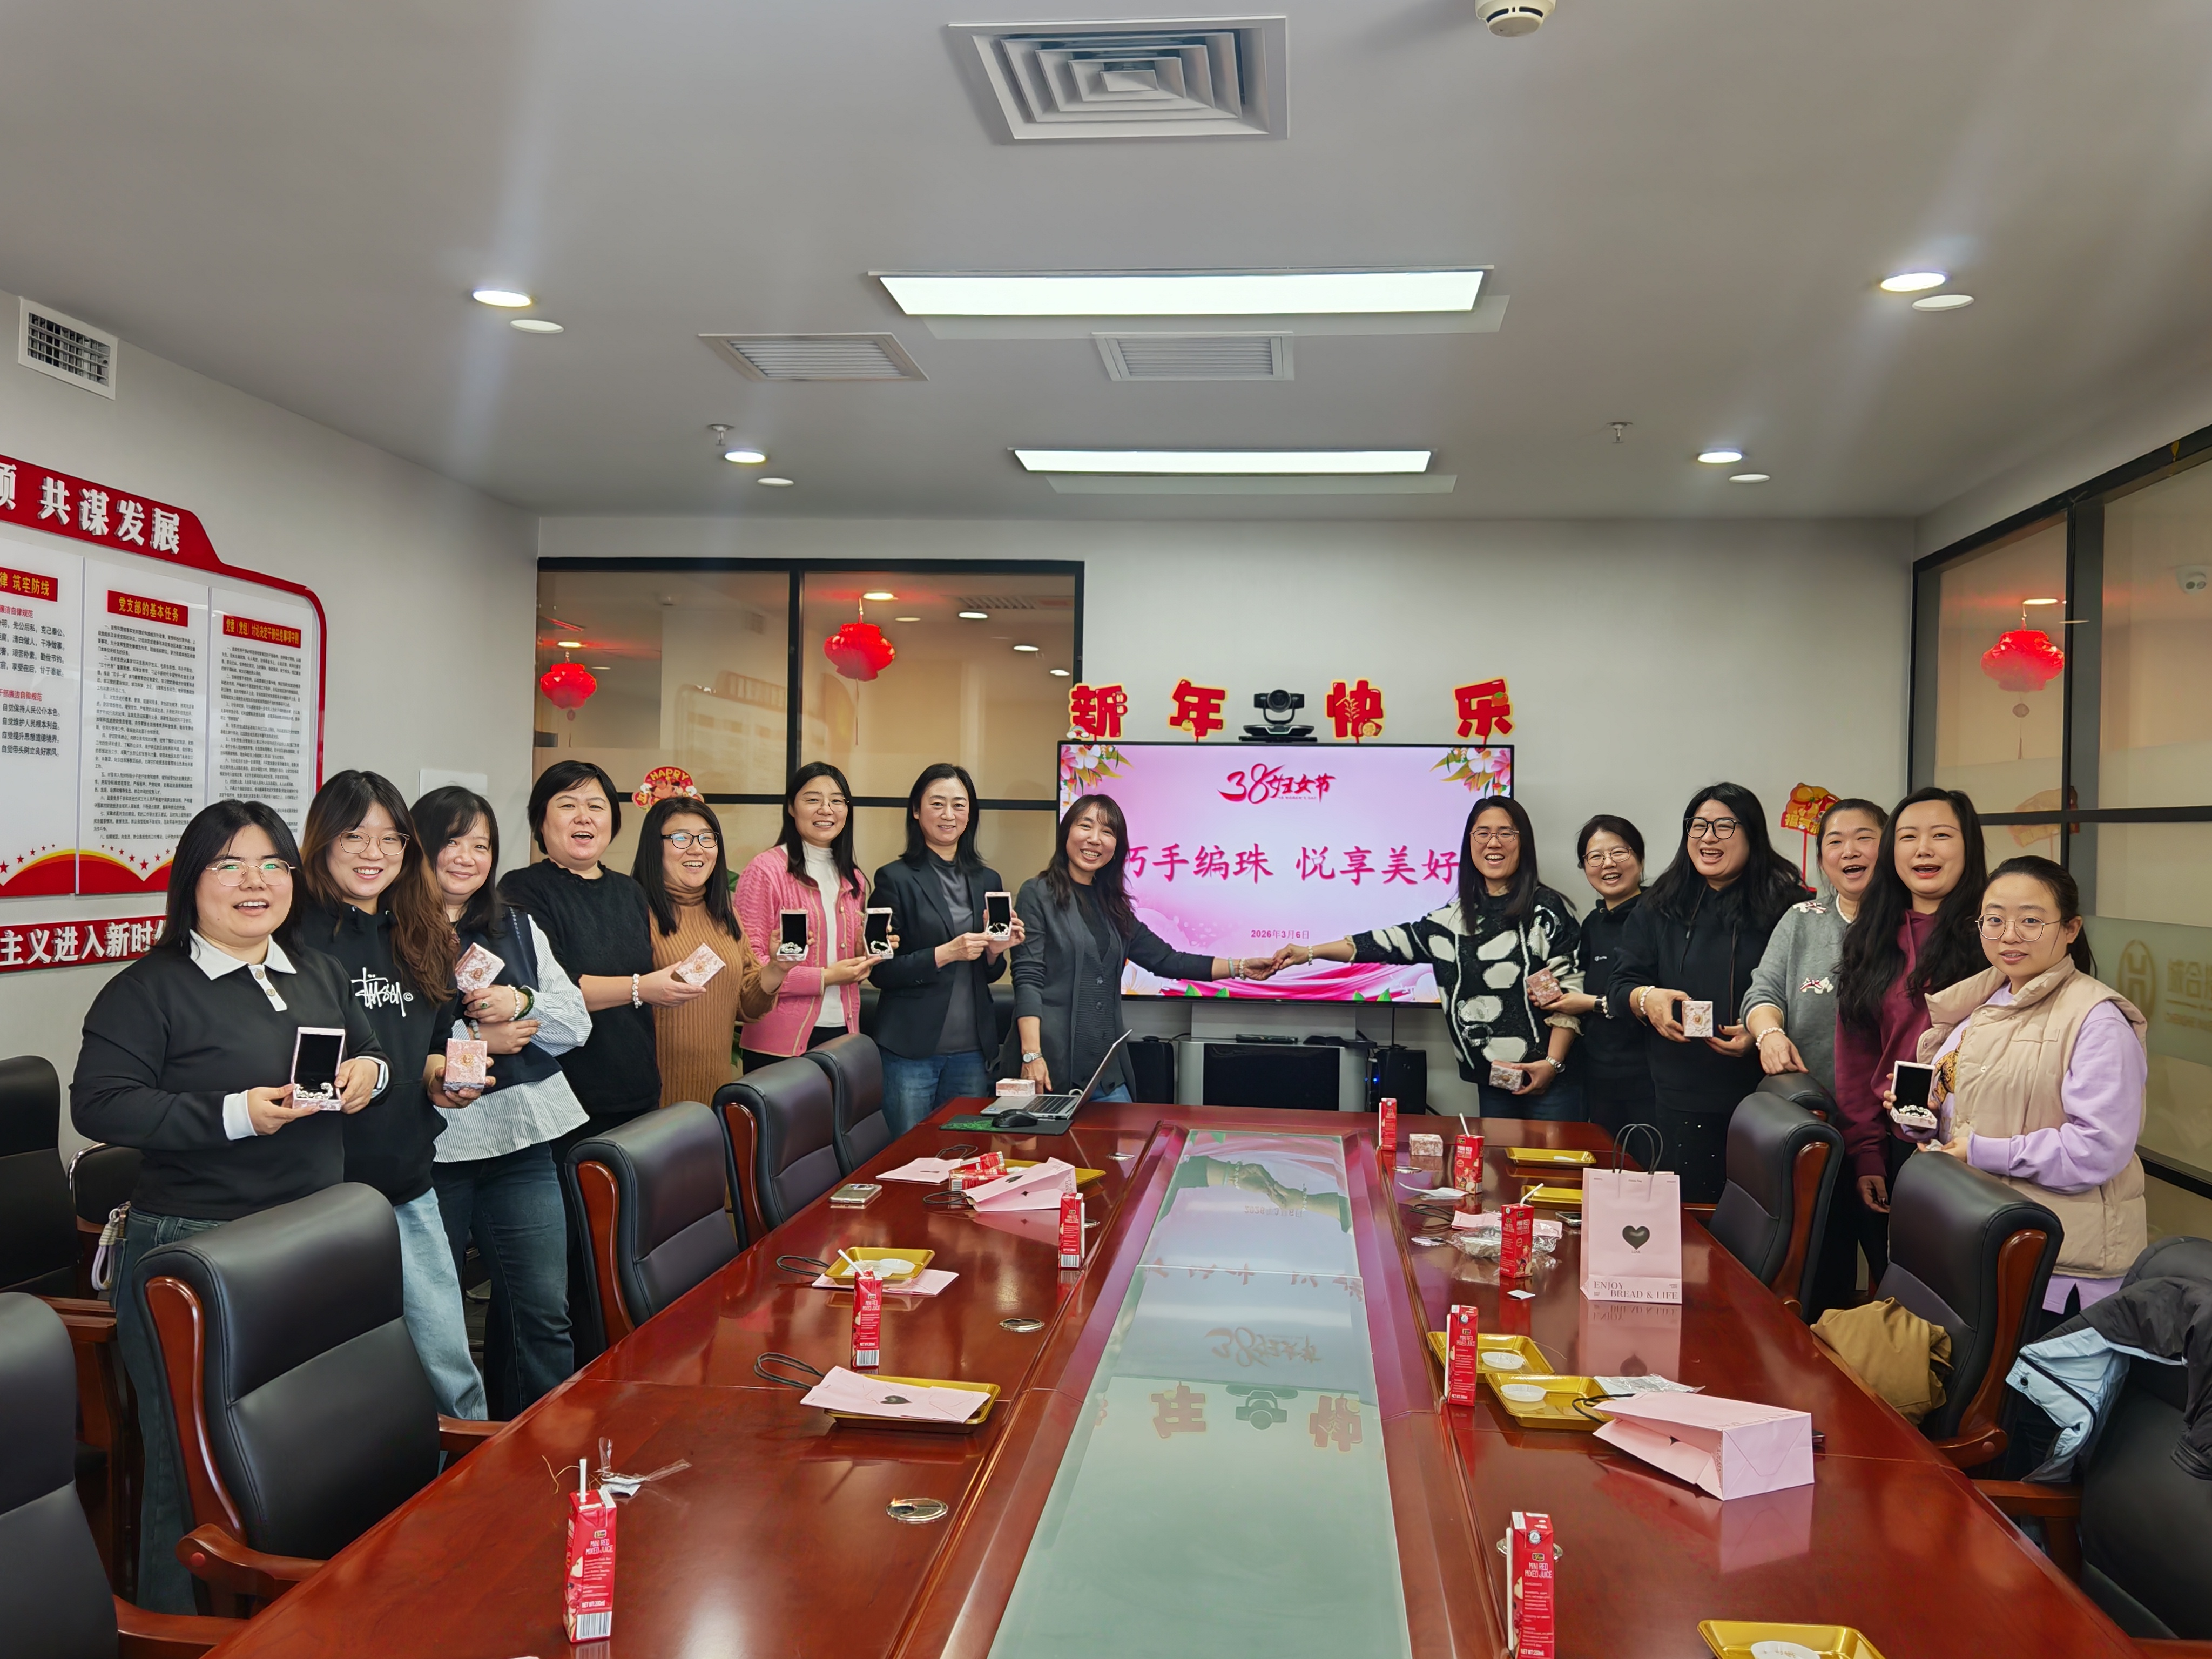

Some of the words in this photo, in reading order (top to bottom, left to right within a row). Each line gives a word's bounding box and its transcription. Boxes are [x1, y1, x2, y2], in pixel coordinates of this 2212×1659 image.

[38, 476, 180, 554] 共谋发展
[12, 574, 49, 596] 筑牢防线
[118, 596, 179, 622] 党支部的基本任务
[1071, 685, 1125, 738] 新
[1170, 679, 1225, 737] 年
[1327, 680, 1384, 737] 快
[1455, 679, 1513, 738] 乐
[650, 768, 689, 781] HAPPY
[1296, 845, 1460, 886] 悦享美好
[1251, 929, 1309, 939] 2026年3月6日
[1594, 1280, 1624, 1290] ENJOY
[1610, 1290, 1643, 1298] BREAD
[1646, 1291, 1654, 1299] &
[1656, 1291, 1678, 1300] LIFE
